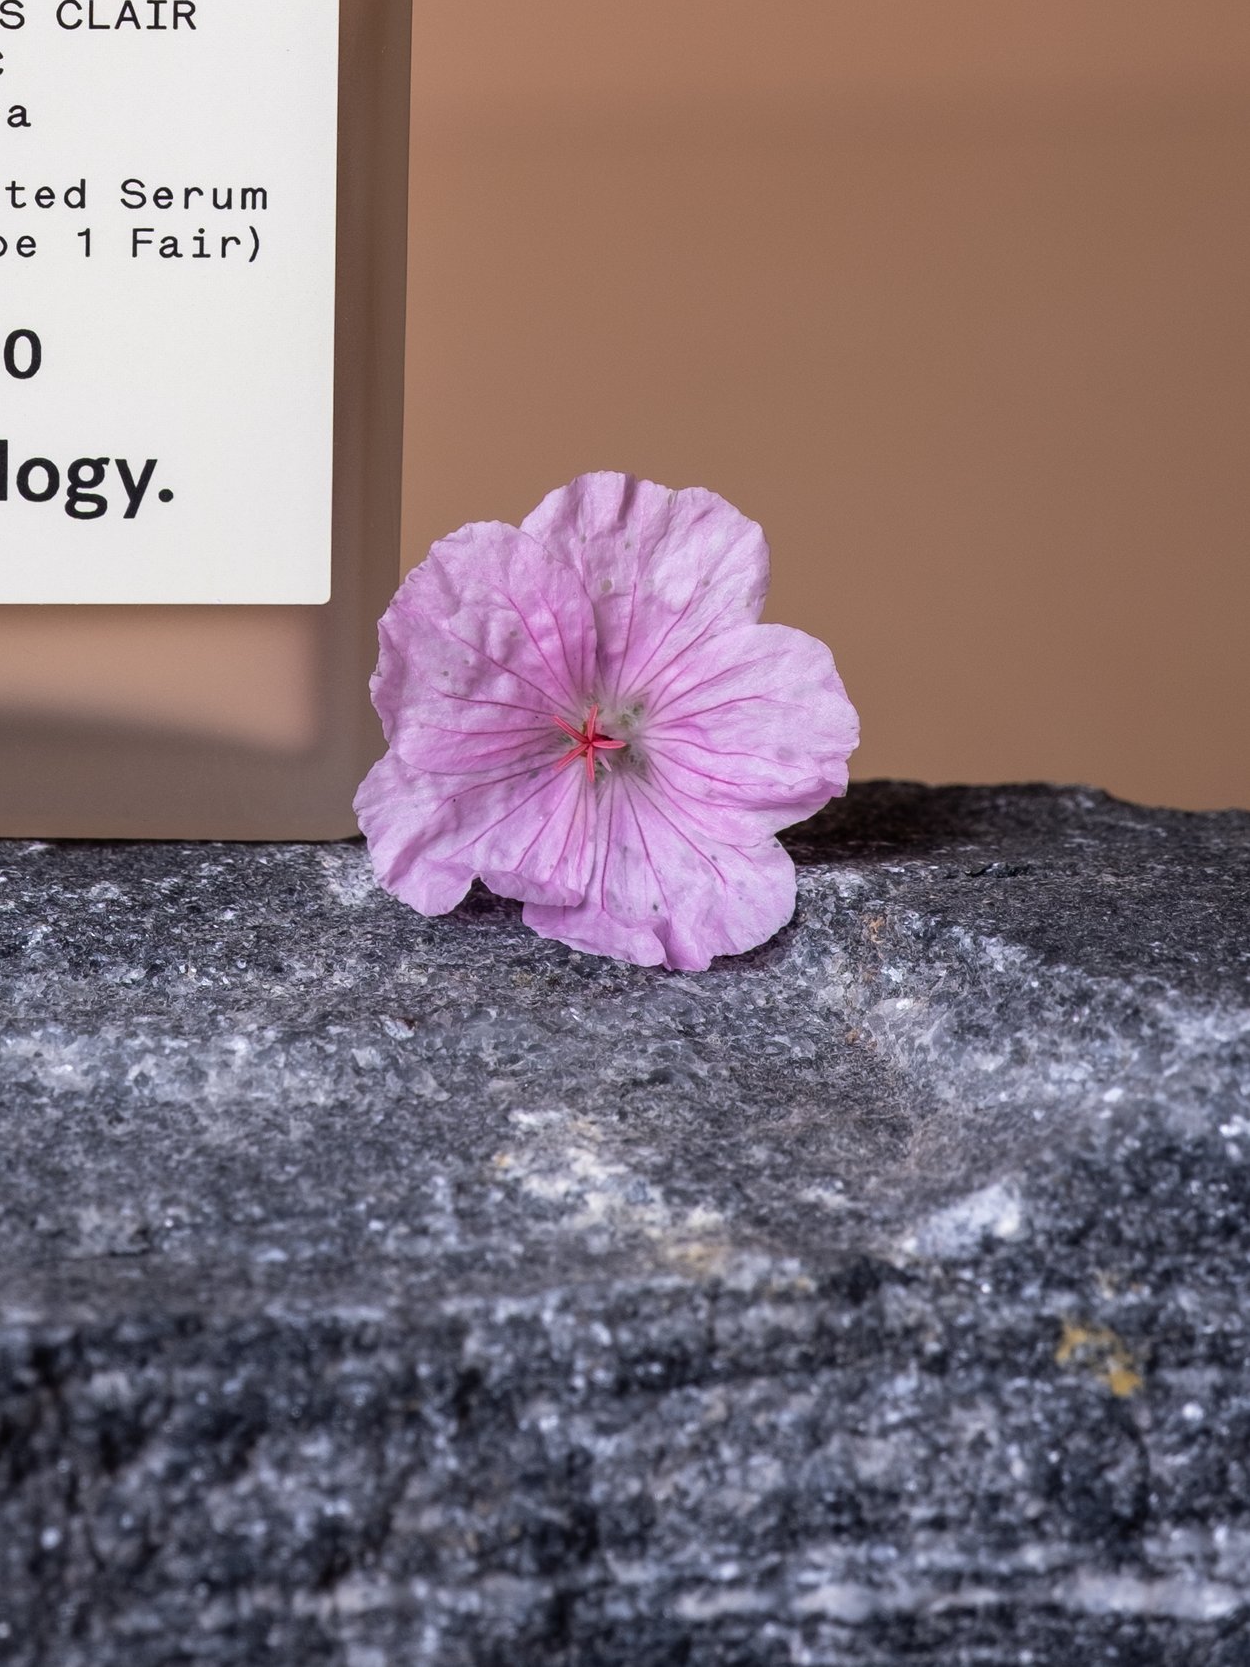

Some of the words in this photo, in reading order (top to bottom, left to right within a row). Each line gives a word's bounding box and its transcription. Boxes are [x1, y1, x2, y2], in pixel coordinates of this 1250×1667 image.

[120, 178, 268, 211] Serum
[77, 227, 91, 258] 1
[131, 225, 260, 263] Fair)
